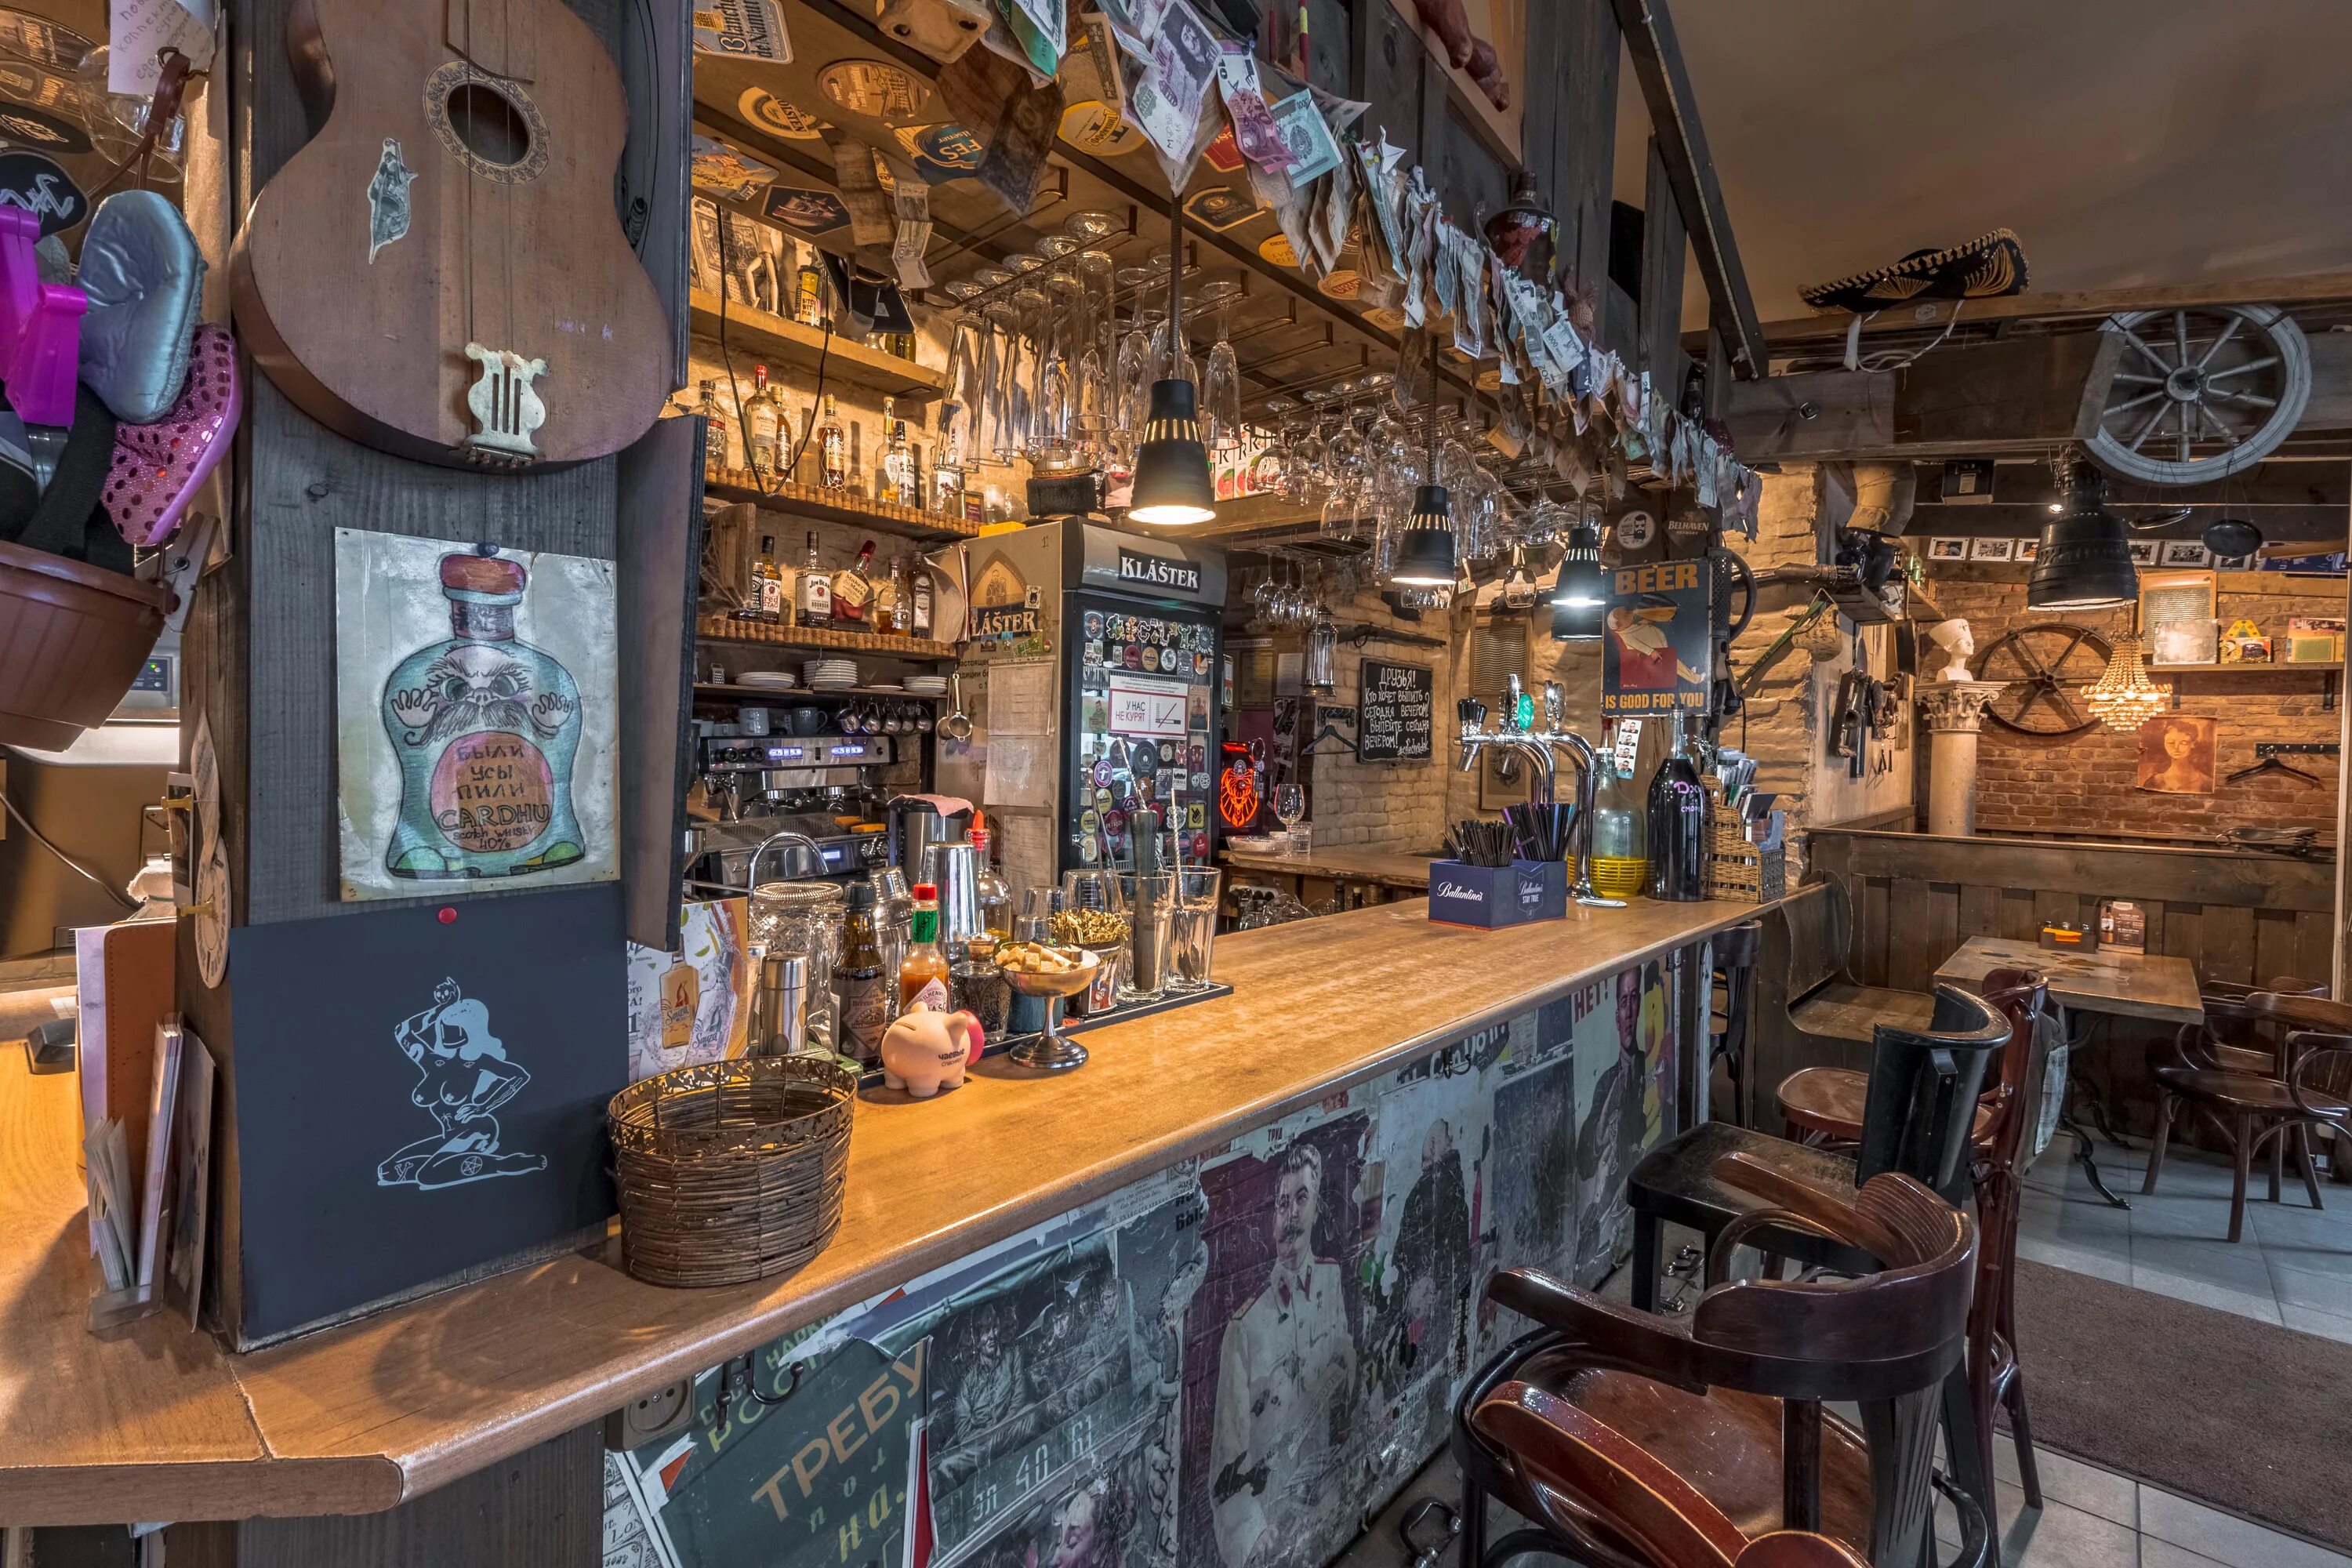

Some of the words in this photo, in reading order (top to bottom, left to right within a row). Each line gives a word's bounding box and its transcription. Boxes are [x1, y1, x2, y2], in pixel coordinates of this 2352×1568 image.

[776, 99, 807, 133] OLSTEN
[938, 130, 971, 143] ilsener
[939, 138, 983, 161] FES
[1546, 332, 1559, 349] 1000
[1668, 521, 1710, 532] BELHAVEN
[1120, 555, 1199, 590] KLÁŠTER
[1615, 564, 1699, 596] BEER
[809, 579, 820, 590] JIM
[819, 579, 830, 590] BEAM
[971, 610, 1036, 637] LÁŠTER
[1126, 700, 1131, 710] У
[1131, 700, 1146, 712] НАС
[1605, 695, 1617, 710] IS
[1619, 694, 1650, 710] GOOD
[1652, 693, 1676, 709] FOR
[1679, 691, 1704, 708] YOU
[1116, 711, 1125, 721] НЕ
[1126, 711, 1146, 723] КУРЯТ
[437, 801, 552, 831] CARDHU
[1680, 804, 1701, 814] смор
[479, 837, 511, 850] 40%
[1436, 881, 1484, 902] Ballantine's
[1518, 880, 1544, 896] Ballantine's
[1522, 895, 1530, 904] STAY
[1530, 895, 1539, 903] TRUE
[666, 1006, 690, 1026] Sauza
[691, 1032, 718, 1049] Sauza
[938, 1047, 965, 1061] чаевые
[750, 1338, 927, 1523] ТРЕБУ
[1015, 1443, 1048, 1490] 40
